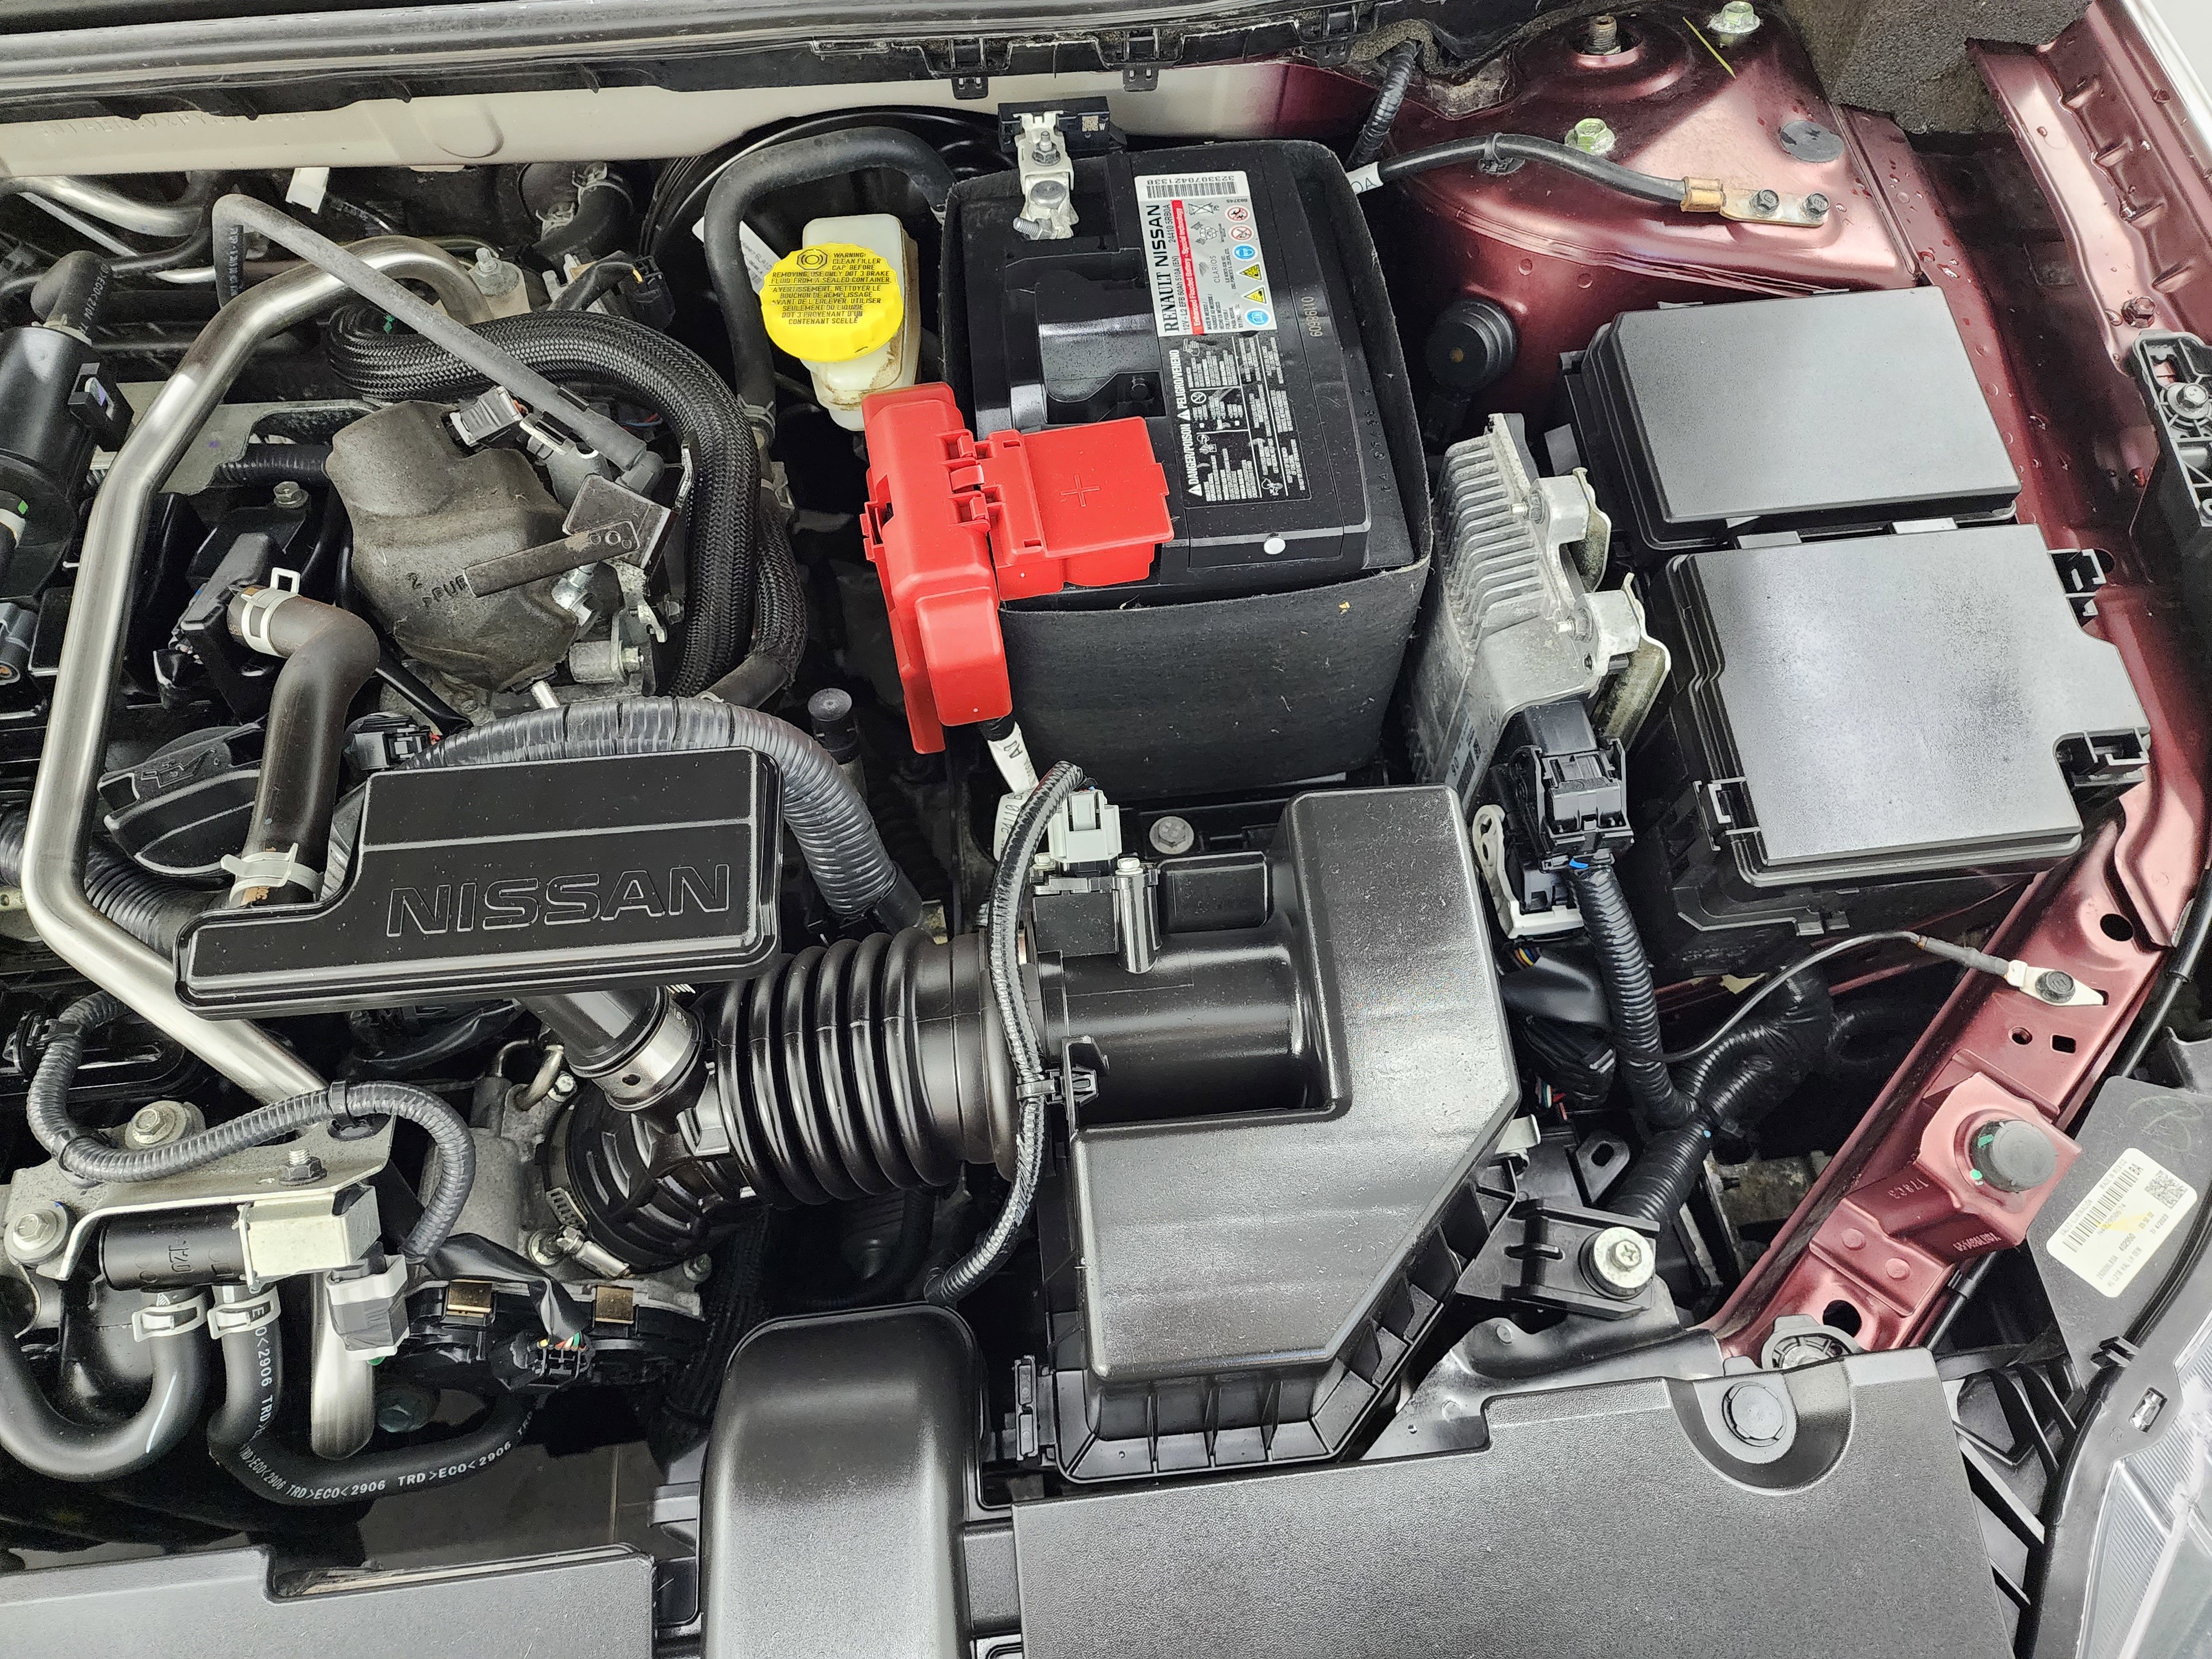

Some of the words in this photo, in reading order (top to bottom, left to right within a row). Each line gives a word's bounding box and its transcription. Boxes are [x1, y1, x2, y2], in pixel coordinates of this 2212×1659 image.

[1175, 207, 1187, 235] technology
[1145, 205, 1169, 267] NISSAN
[1165, 225, 1175, 243] 24410
[1179, 236, 1190, 254] Special
[1171, 255, 1181, 267] (EN)
[1183, 257, 1194, 277] Battery
[1209, 255, 1220, 283] CLARIOS
[1173, 268, 1182, 280] 510A
[1175, 281, 1184, 295] 60Ah
[1186, 277, 1197, 299] Flooded
[1156, 271, 1180, 332] RENAULT
[1177, 296, 1186, 307] EFB
[1190, 299, 1201, 326] Enhanced
[1181, 320, 1190, 330] 12V
[1168, 349, 1188, 409] PELIGRO/VENENO
[1180, 423, 1199, 484] DANGER/POISON
[387, 864, 731, 937] NISSAN
[2127, 1161, 2144, 1176] BA
[2117, 1232, 2136, 1253] 402950
